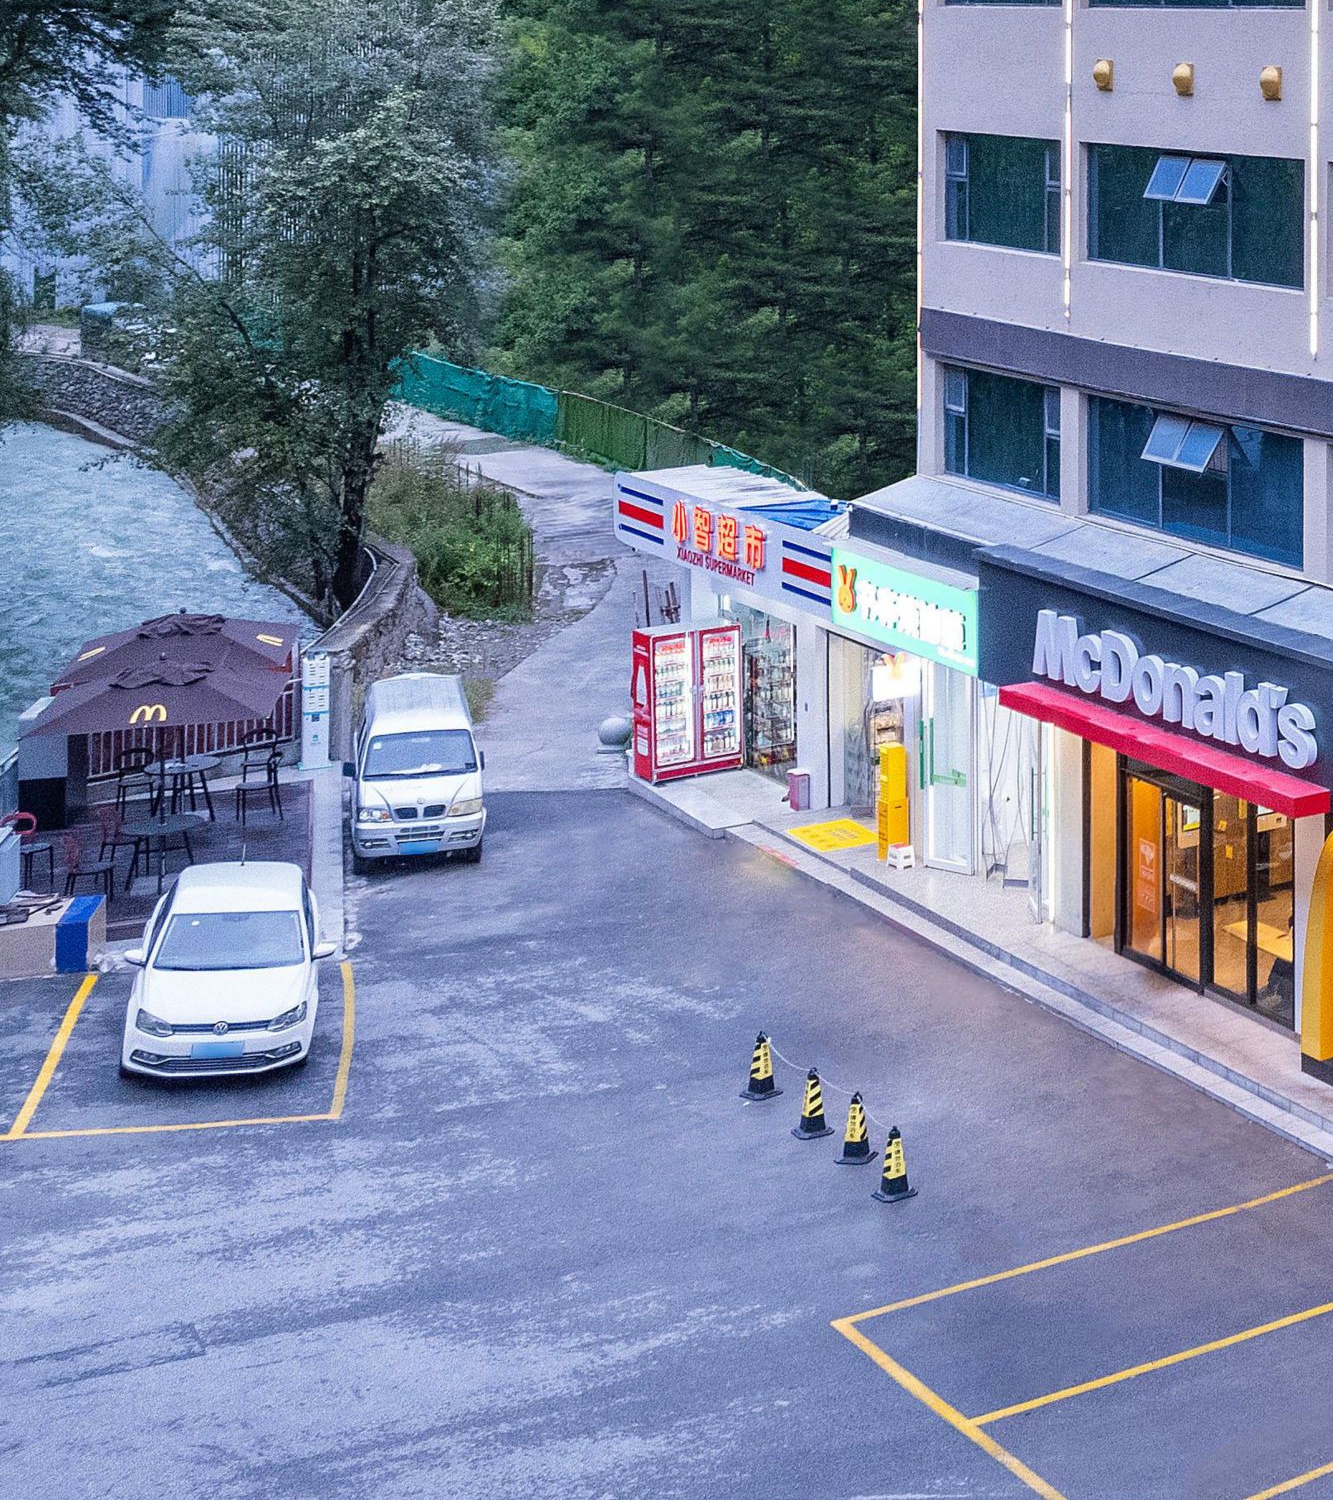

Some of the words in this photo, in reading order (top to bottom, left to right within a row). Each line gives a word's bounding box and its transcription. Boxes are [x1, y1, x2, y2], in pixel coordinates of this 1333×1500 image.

[671, 499, 766, 571] 小智超市
[677, 546, 704, 568] XIAOZHI
[705, 555, 756, 587] SUPERMARKET
[1032, 609, 1318, 770] McDonald's
